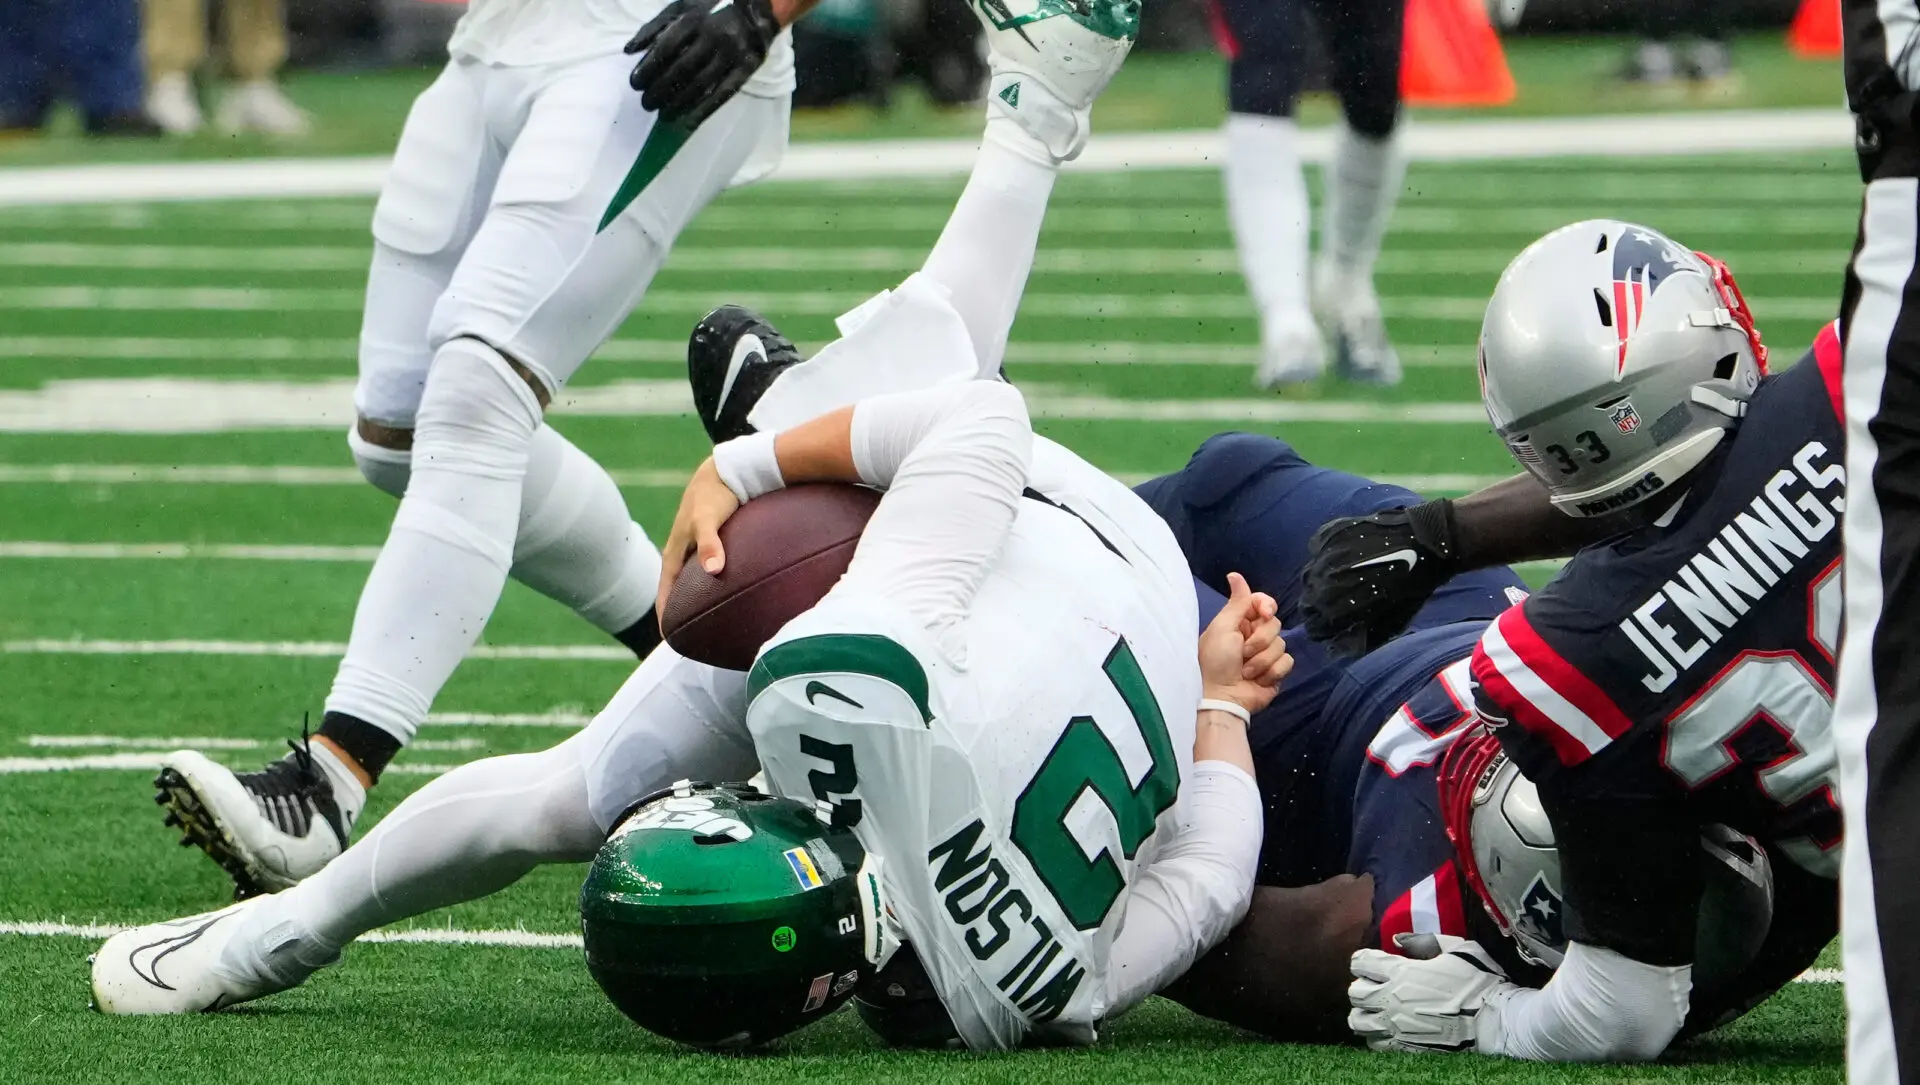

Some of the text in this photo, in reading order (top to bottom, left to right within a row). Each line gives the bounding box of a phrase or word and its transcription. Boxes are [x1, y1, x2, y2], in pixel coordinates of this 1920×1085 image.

[1546, 430, 1611, 475] 33
[1617, 415, 1639, 433] NFL
[1618, 441, 1846, 694] JENNINGS
[799, 733, 863, 831] 2
[1010, 634, 1181, 932] 2
[838, 914, 857, 935] 2
[928, 818, 1087, 1024] WILSON
